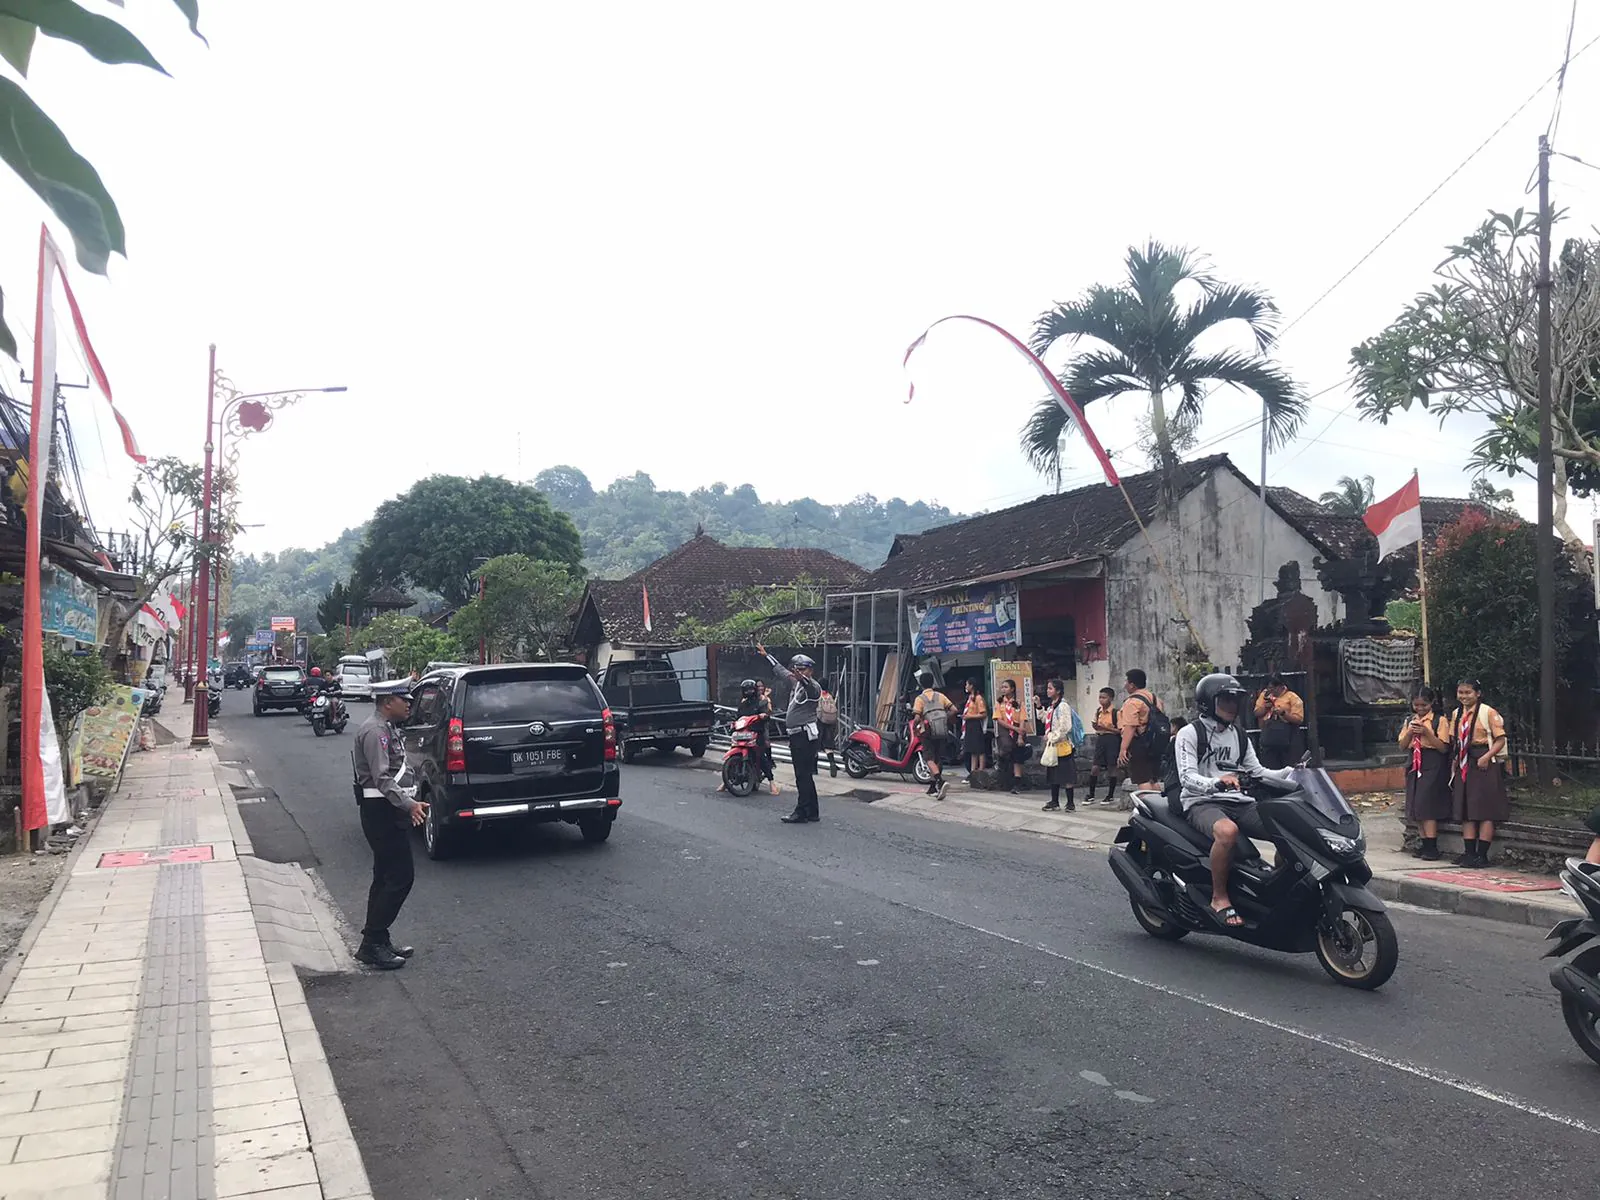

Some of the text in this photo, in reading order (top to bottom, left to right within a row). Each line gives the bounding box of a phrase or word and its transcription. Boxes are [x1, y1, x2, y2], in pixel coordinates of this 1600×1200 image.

[951, 602, 985, 615] PRINTING
[525, 750, 544, 761] 1051
[546, 749, 562, 760] FBE
